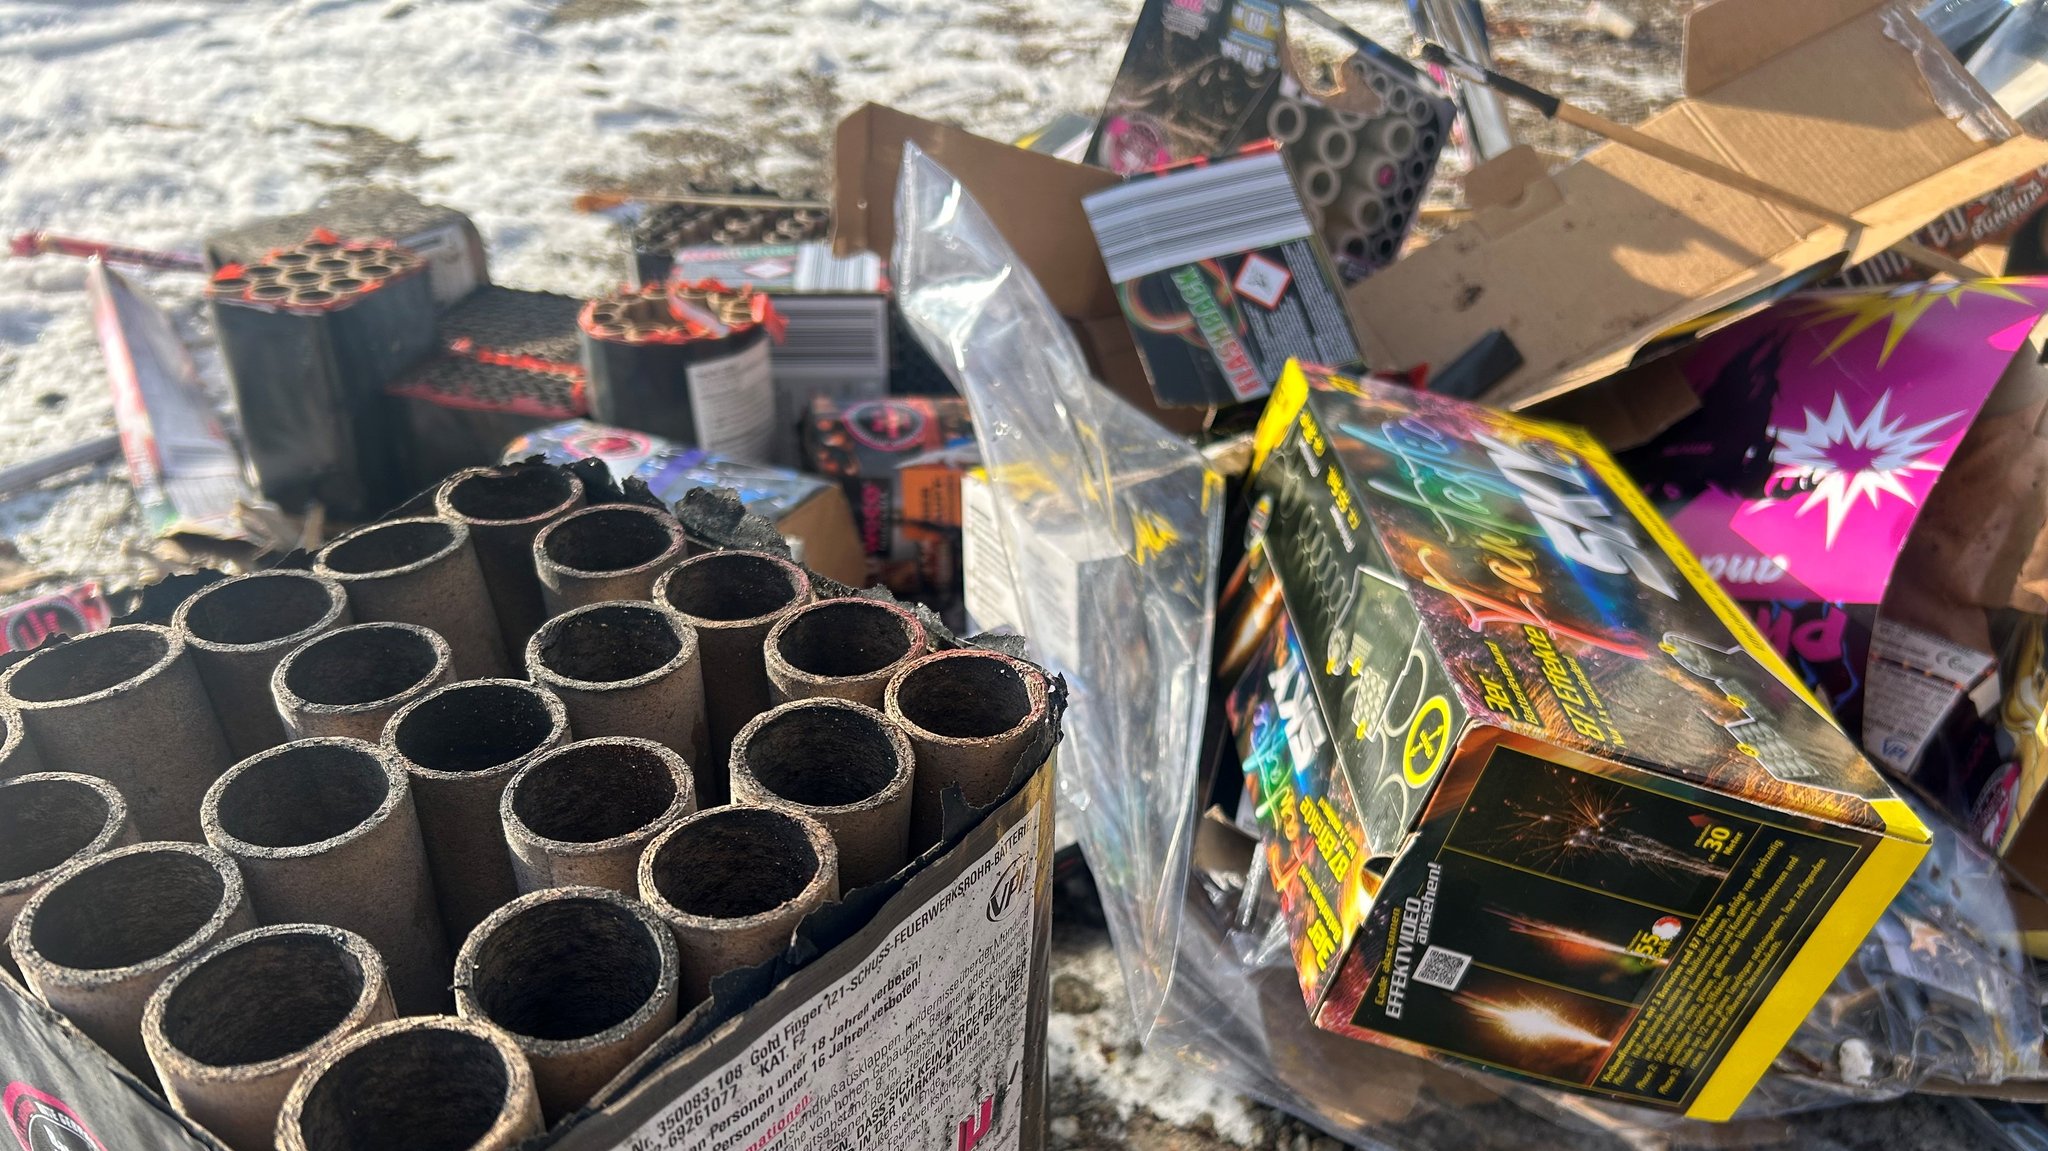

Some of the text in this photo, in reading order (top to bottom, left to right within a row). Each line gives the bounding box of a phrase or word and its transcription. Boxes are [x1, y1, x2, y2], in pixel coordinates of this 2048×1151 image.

[1172, 266, 1262, 397] FLASHBACK
[1472, 429, 1678, 599] SKY
[1268, 657, 1326, 772] SKY
[1479, 674, 1518, 719] 3er
[1523, 624, 1606, 742] 87 Effekte
[1300, 796, 1351, 883] 87 Effekte
[1703, 826, 1731, 852] 30
[1723, 831, 1745, 856] Meter
[1727, 891, 1746, 917] gefolgt
[1743, 877, 1757, 891] von
[1752, 839, 1783, 879] gleichzeitig
[1752, 870, 1789, 917] Leuchtsternen
[1786, 855, 1799, 872] und
[1783, 898, 1797, 913] laut
[1794, 859, 1826, 899] zerlegenden
[1307, 920, 1336, 971] 3er
[1409, 861, 1444, 944] ansehen!
[1635, 932, 1660, 955] 55
[1373, 906, 1404, 1005] Code abscannen
[1378, 896, 1427, 1019] EFFEKTVIDEO
[1651, 997, 1661, 1006] 3
[1656, 964, 1684, 999] Batterien
[1681, 949, 1694, 964] und
[1689, 938, 1700, 949] 87
[1697, 905, 1723, 937] Effekten
[657, 1063, 743, 1138] 350083-108
[751, 1034, 780, 1067] Gold
[784, 1002, 823, 1041] Finger
[709, 1086, 774, 1140] Personen
[777, 1052, 807, 1088] unter
[811, 1036, 826, 1056] 18
[829, 1002, 870, 1042] Jahren
[871, 954, 922, 1005] verboten!
[759, 1049, 788, 1077] KAT.
[792, 1030, 806, 1052] F2
[778, 1071, 808, 1108] unter
[811, 1054, 826, 1073] 16
[829, 1020, 869, 1060] Jahren
[870, 971, 922, 1023] verboten!
[810, 1106, 830, 1134] von
[835, 1073, 869, 1114] hohen
[872, 1022, 926, 1081] Gebäuden,
[929, 984, 965, 1028] Bäumen
[968, 960, 988, 990] oder
[826, 1106, 866, 1151] ebenen
[870, 1073, 900, 1111] Boden
[904, 1039, 935, 1078] stellen
[939, 1020, 955, 1046] und
[957, 1000, 975, 1027] zum
[839, 1027, 903, 1094] ausklappen.
[905, 974, 958, 1037] Hindernisse
[857, 1101, 885, 1140] DASS
[889, 1072, 913, 1106] SICH
[918, 1045, 942, 1080] KEIN
[945, 986, 1001, 1051] KÖRPERTEIL
[1005, 957, 1026, 991] ÜBER
[859, 1130, 871, 1151] IN
[875, 1105, 895, 1134] DER
[900, 1023, 979, 1109] WIRKRICHTUNG
[983, 975, 1023, 1027] BEFINDET
[876, 1075, 881, 1092] 8
[918, 1075, 940, 1105] Ende
[946, 1029, 987, 1077] anzünden
[888, 1064, 965, 1151] Feuerwerkskörper
[968, 1040, 990, 1067] seine
[933, 1093, 950, 1118] zum
